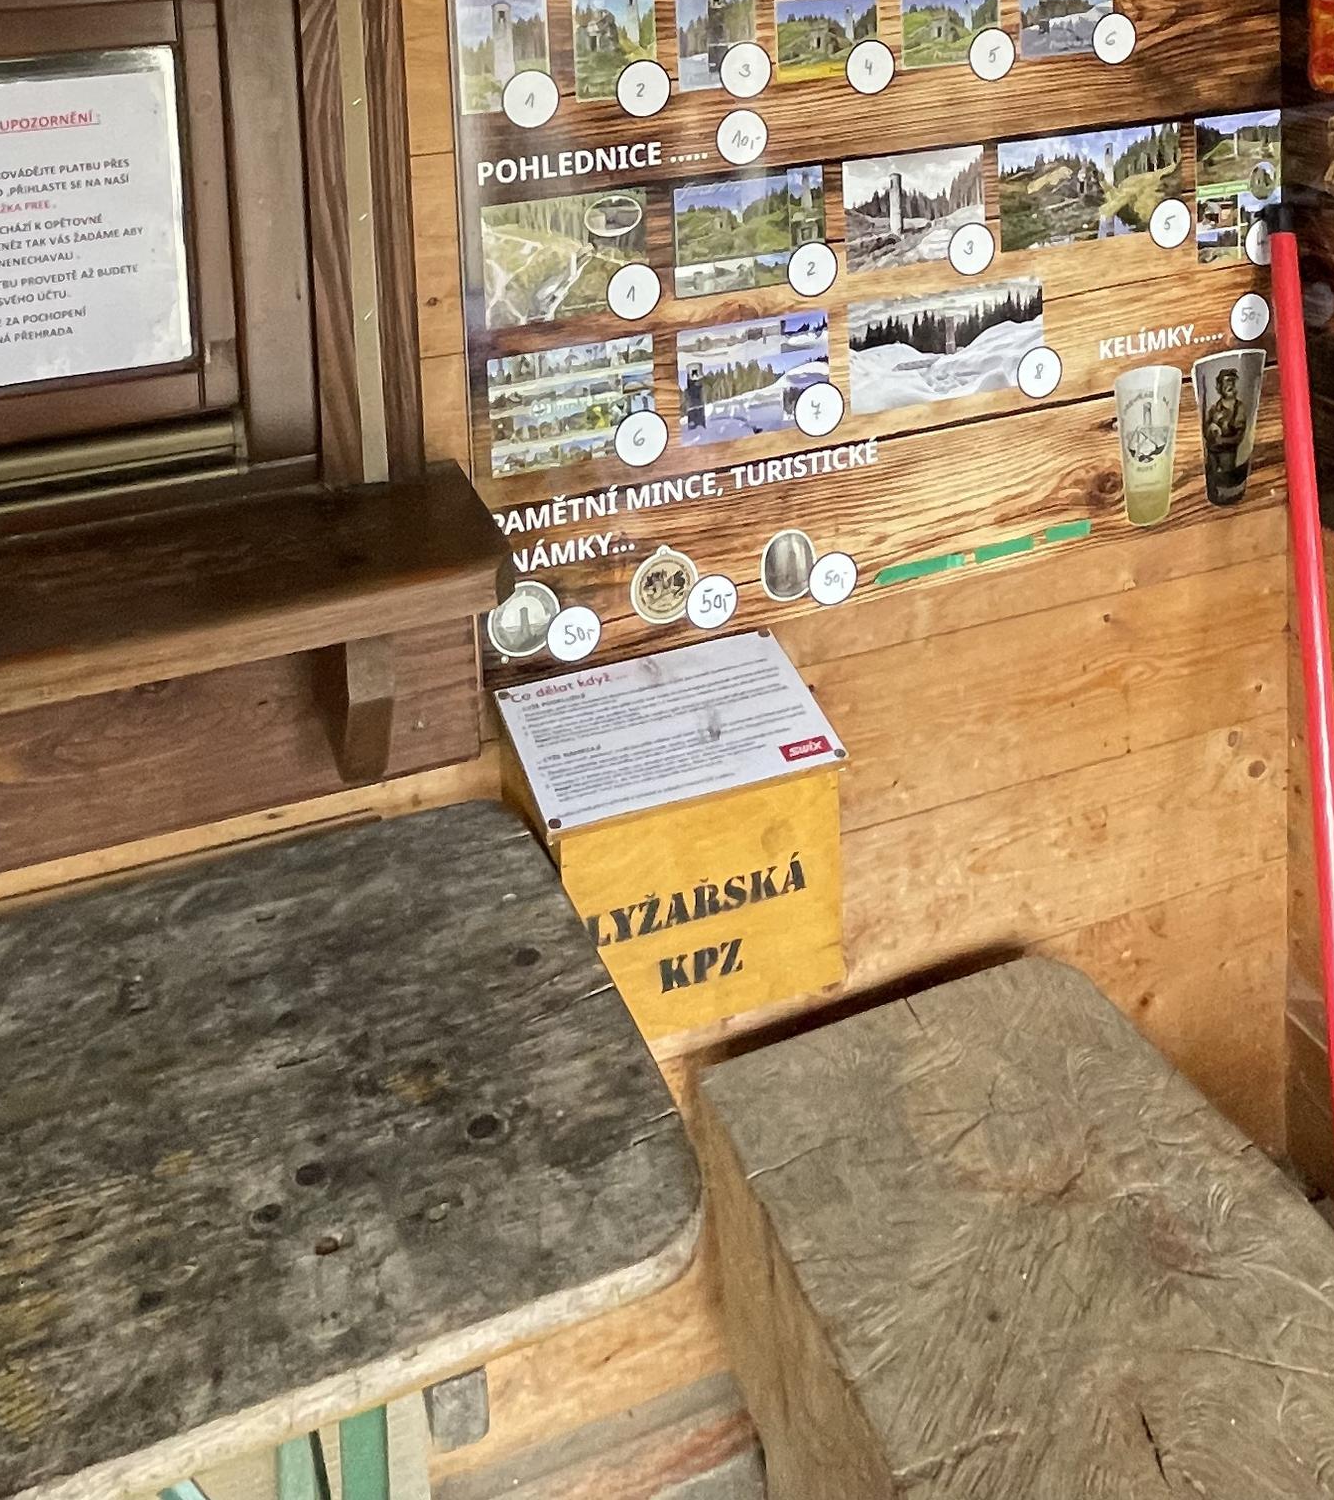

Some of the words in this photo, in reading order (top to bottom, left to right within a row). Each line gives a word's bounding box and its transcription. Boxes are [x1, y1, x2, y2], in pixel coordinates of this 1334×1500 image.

[0, 109, 94, 132] UPOZORNĚNÍ
[59, 162, 101, 174] PLATBU
[103, 158, 130, 170] PŘES
[476, 142, 663, 187] POHLEDNICE
[5, 315, 20, 326] ZA
[22, 305, 87, 324] POCHOPENÍ
[14, 325, 74, 343] PŘEHRADA
[631, 428, 646, 447] 6
[624, 472, 725, 511] MINCE,
[730, 438, 880, 490] TURISTICKÉ
[513, 531, 636, 574] NÁMKY...
[585, 852, 808, 947] LYŽAŘSKÁ
[658, 937, 745, 994] KPZ
